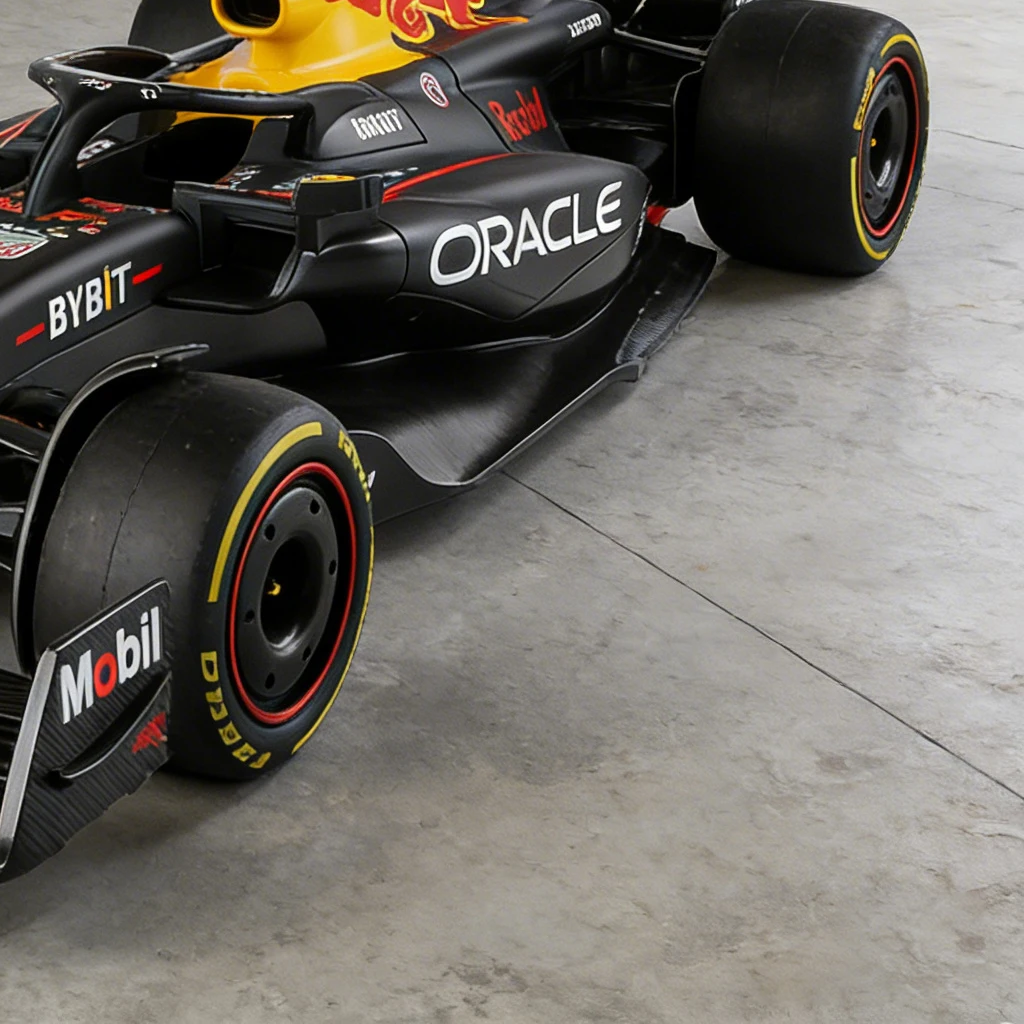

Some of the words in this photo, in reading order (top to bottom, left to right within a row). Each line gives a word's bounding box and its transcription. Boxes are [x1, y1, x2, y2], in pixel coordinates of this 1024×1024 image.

[430, 180, 623, 286] ORACLE
[48, 261, 133, 341] BYBIT
[59, 605, 161, 725] Mobil
